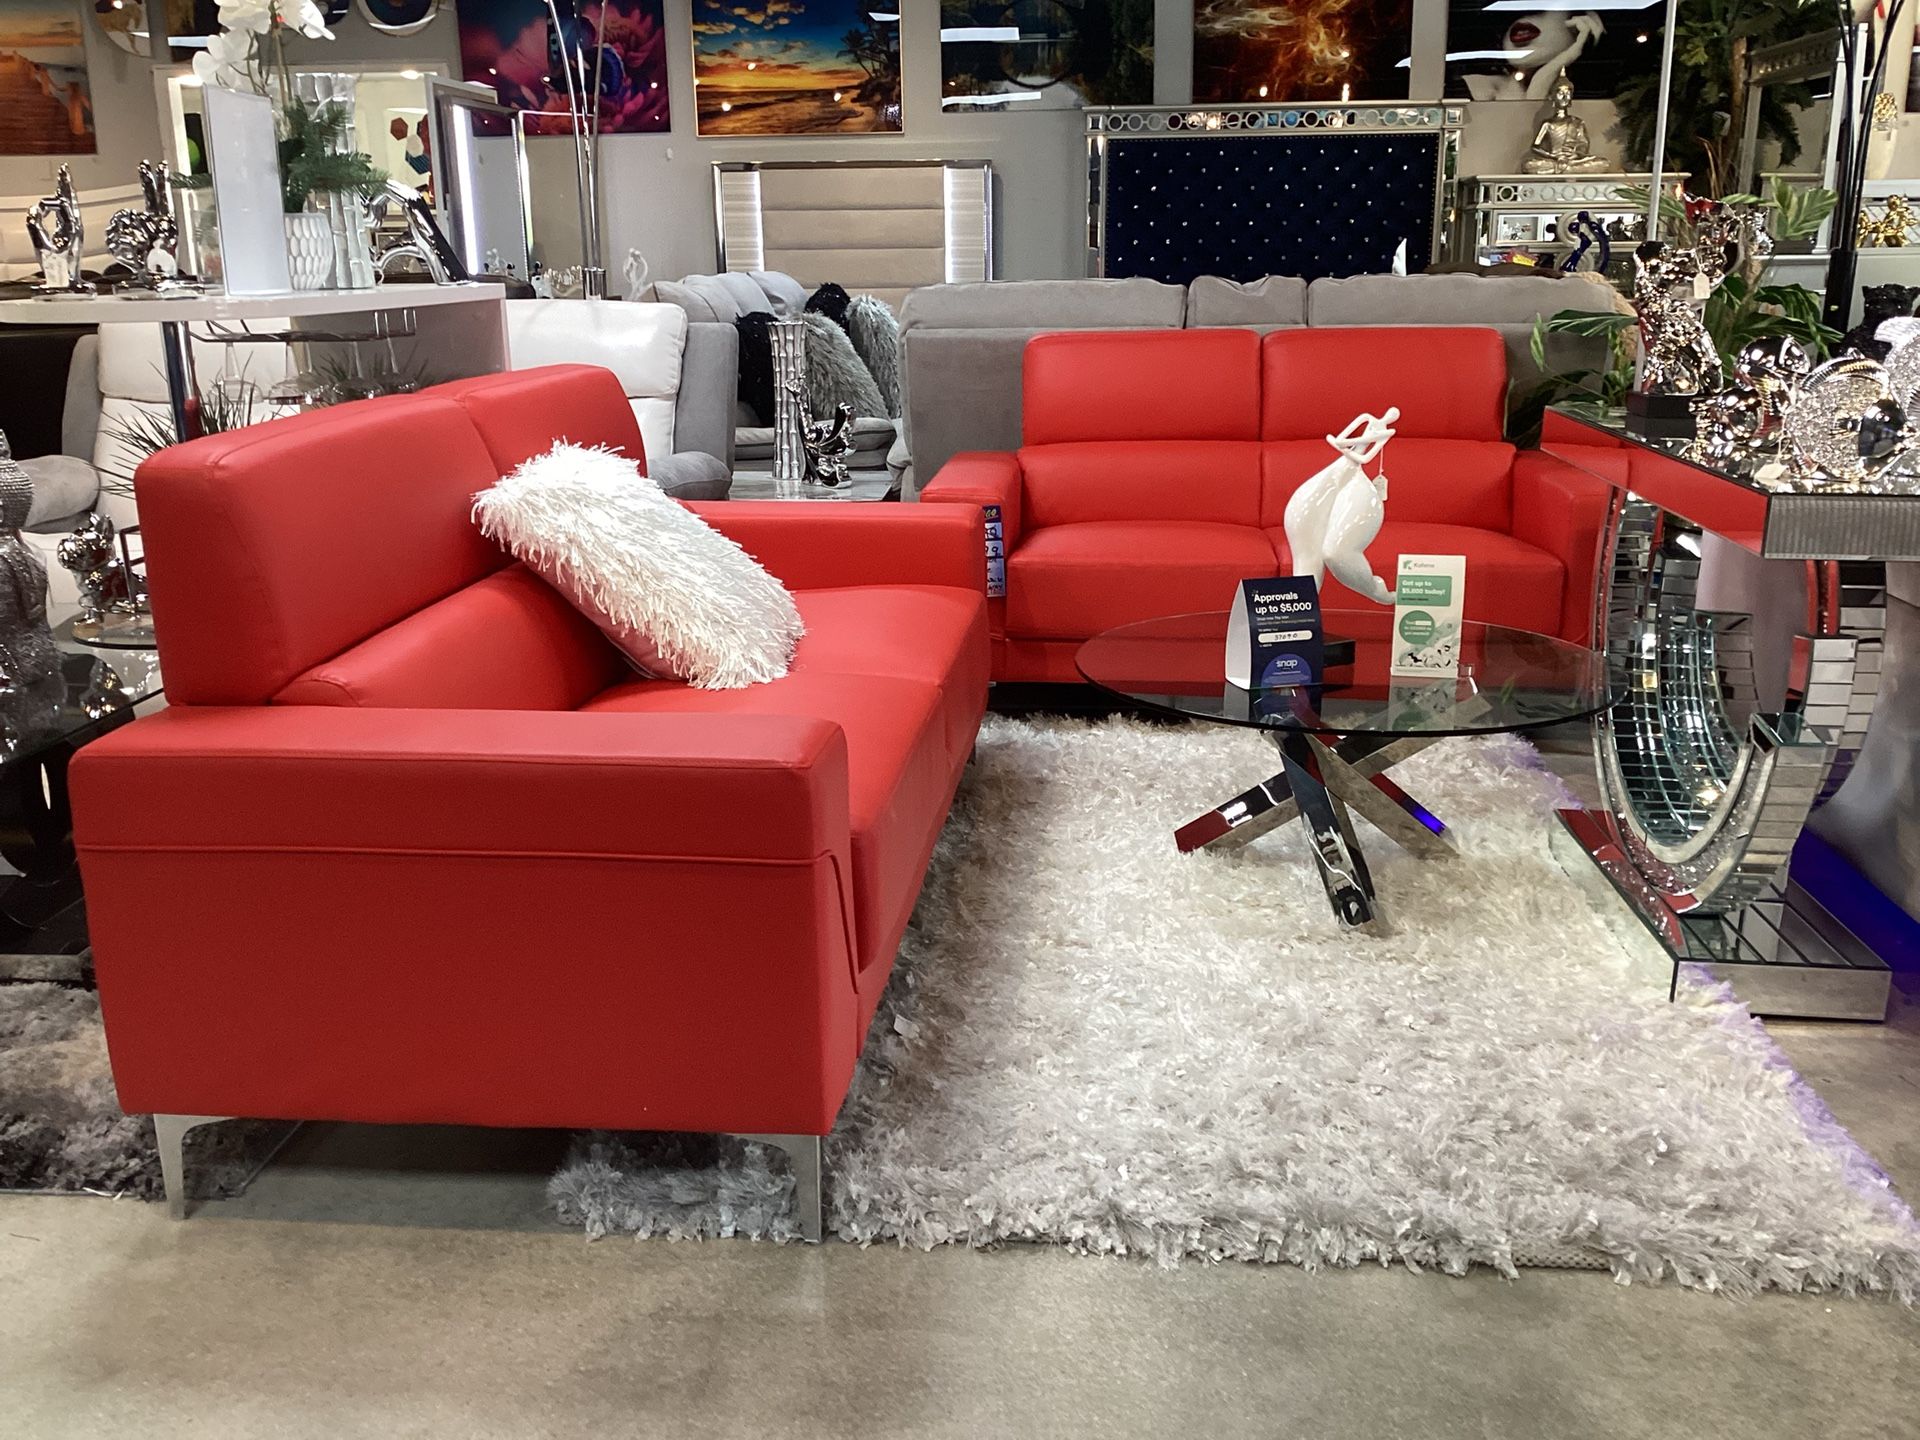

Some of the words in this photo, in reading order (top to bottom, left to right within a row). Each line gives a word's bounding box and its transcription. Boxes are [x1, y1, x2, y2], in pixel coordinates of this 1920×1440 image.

[1254, 592, 1299, 603] Approvals
[1255, 606, 1268, 615] up
[1268, 604, 1279, 613] to
[1275, 659, 1298, 669] snap
